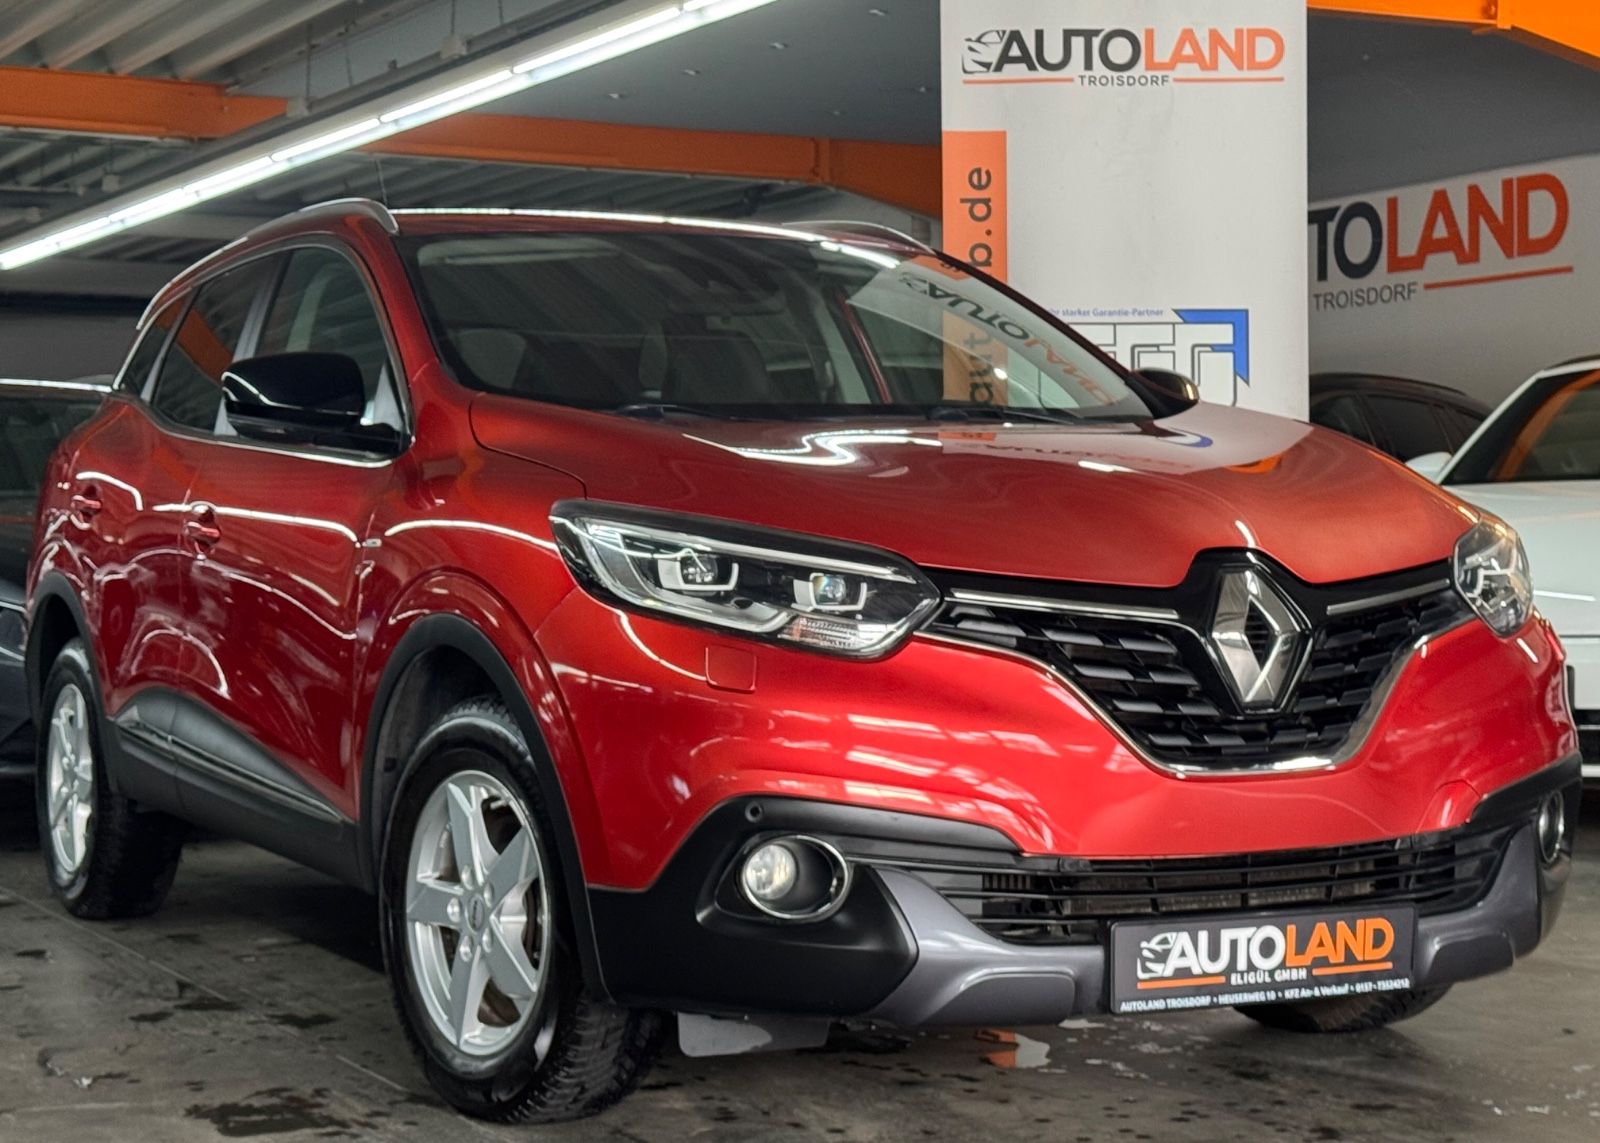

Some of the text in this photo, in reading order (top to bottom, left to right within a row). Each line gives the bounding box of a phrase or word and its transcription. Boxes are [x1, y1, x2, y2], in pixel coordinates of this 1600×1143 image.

[992, 27, 1286, 73] AUTOLAND
[1078, 74, 1170, 87] TROISDORF
[1313, 281, 1418, 311] TROISDORF
[1092, 307, 1164, 317] Garantie-Partner
[1164, 917, 1395, 976] AUTOLAND
[1230, 967, 1308, 986] ELIGÜL GMBH
